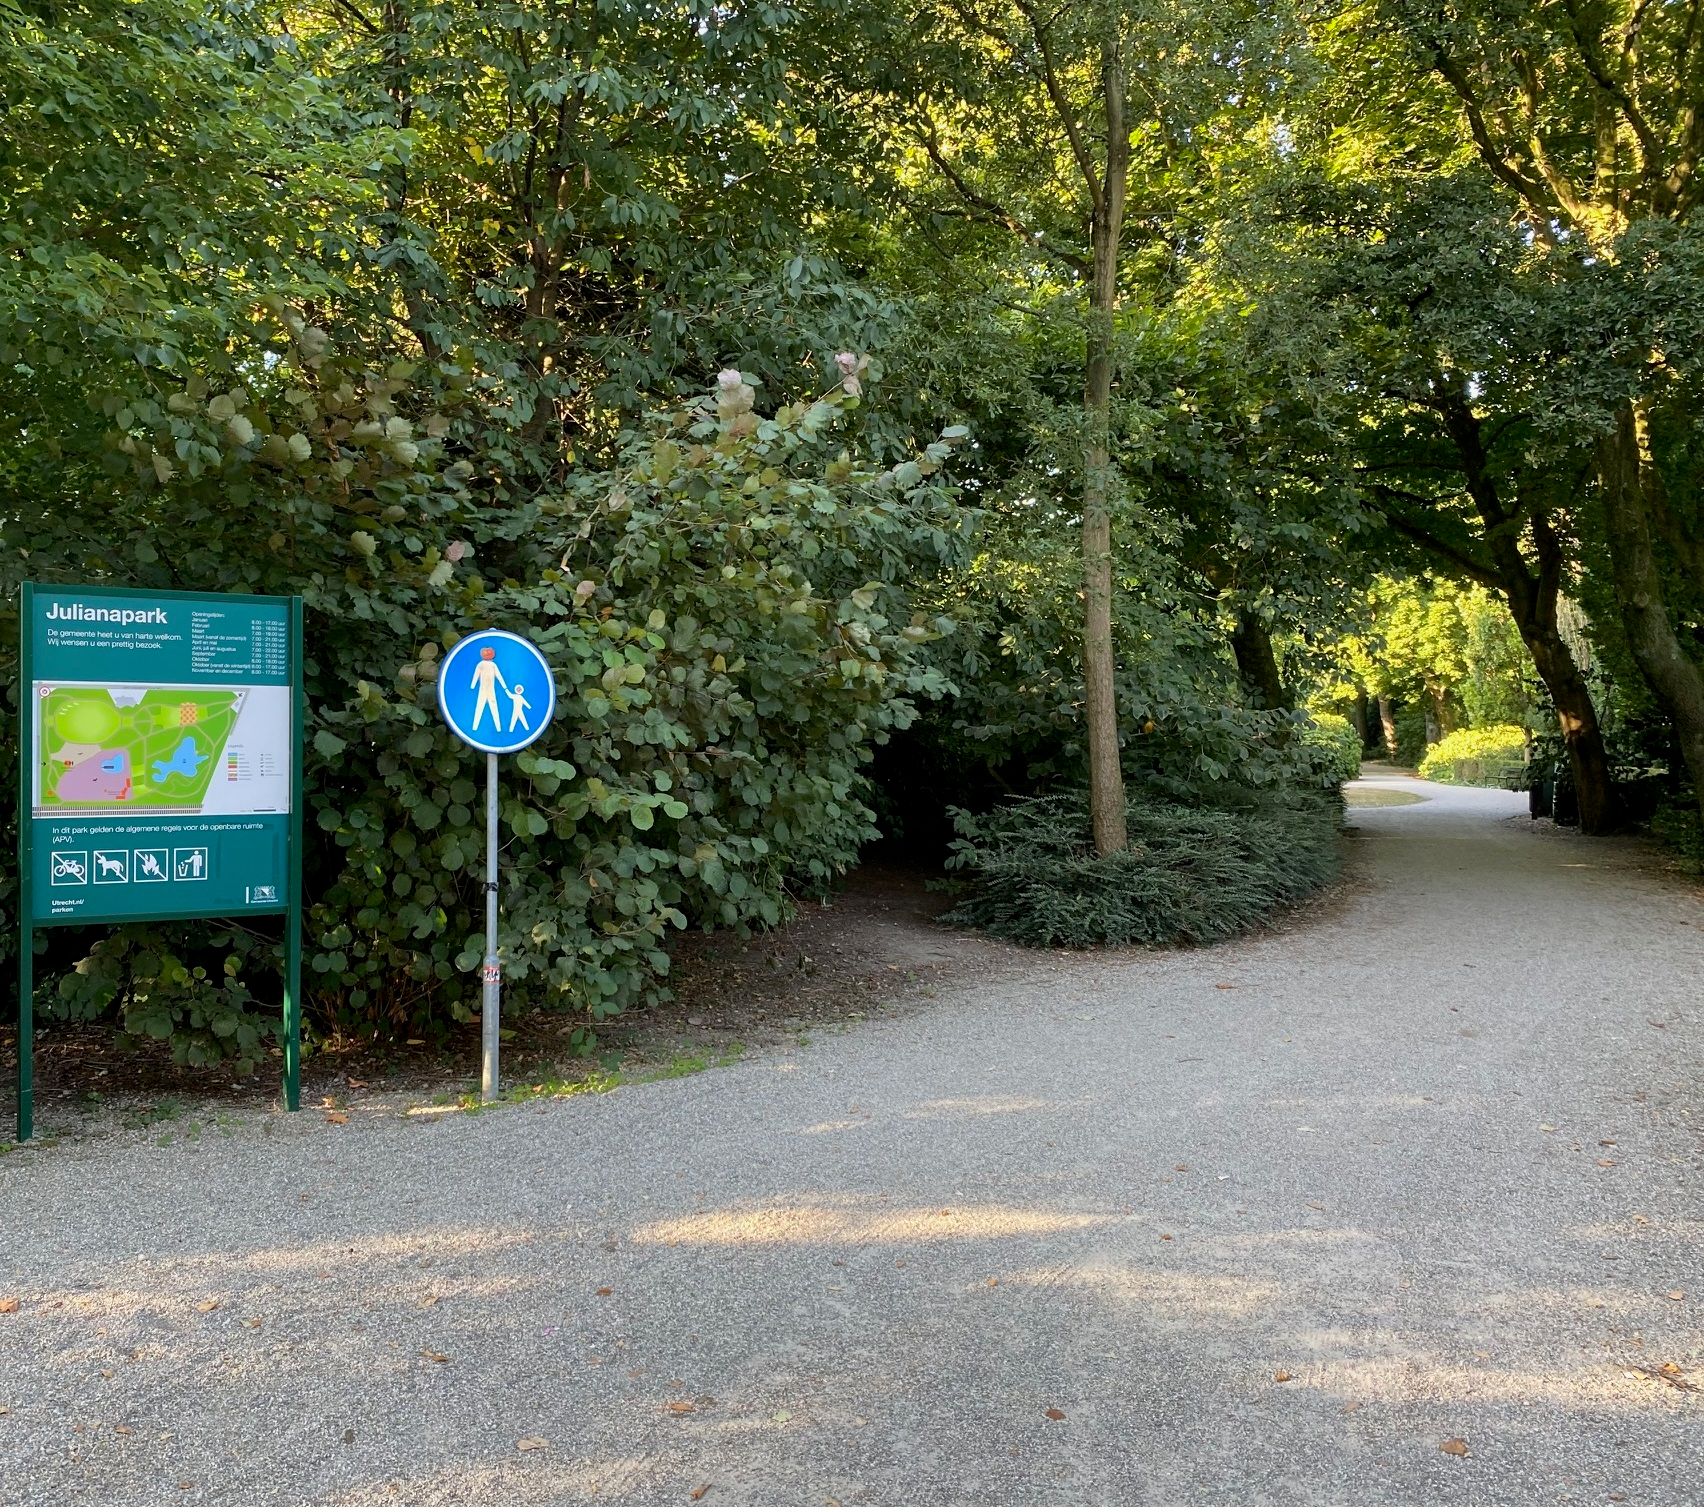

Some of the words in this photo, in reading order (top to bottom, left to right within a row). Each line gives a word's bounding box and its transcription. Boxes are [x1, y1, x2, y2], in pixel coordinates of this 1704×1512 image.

[46, 602, 168, 625] Julianapark
[112, 641, 134, 649] prettig
[126, 826, 159, 834] algemene
